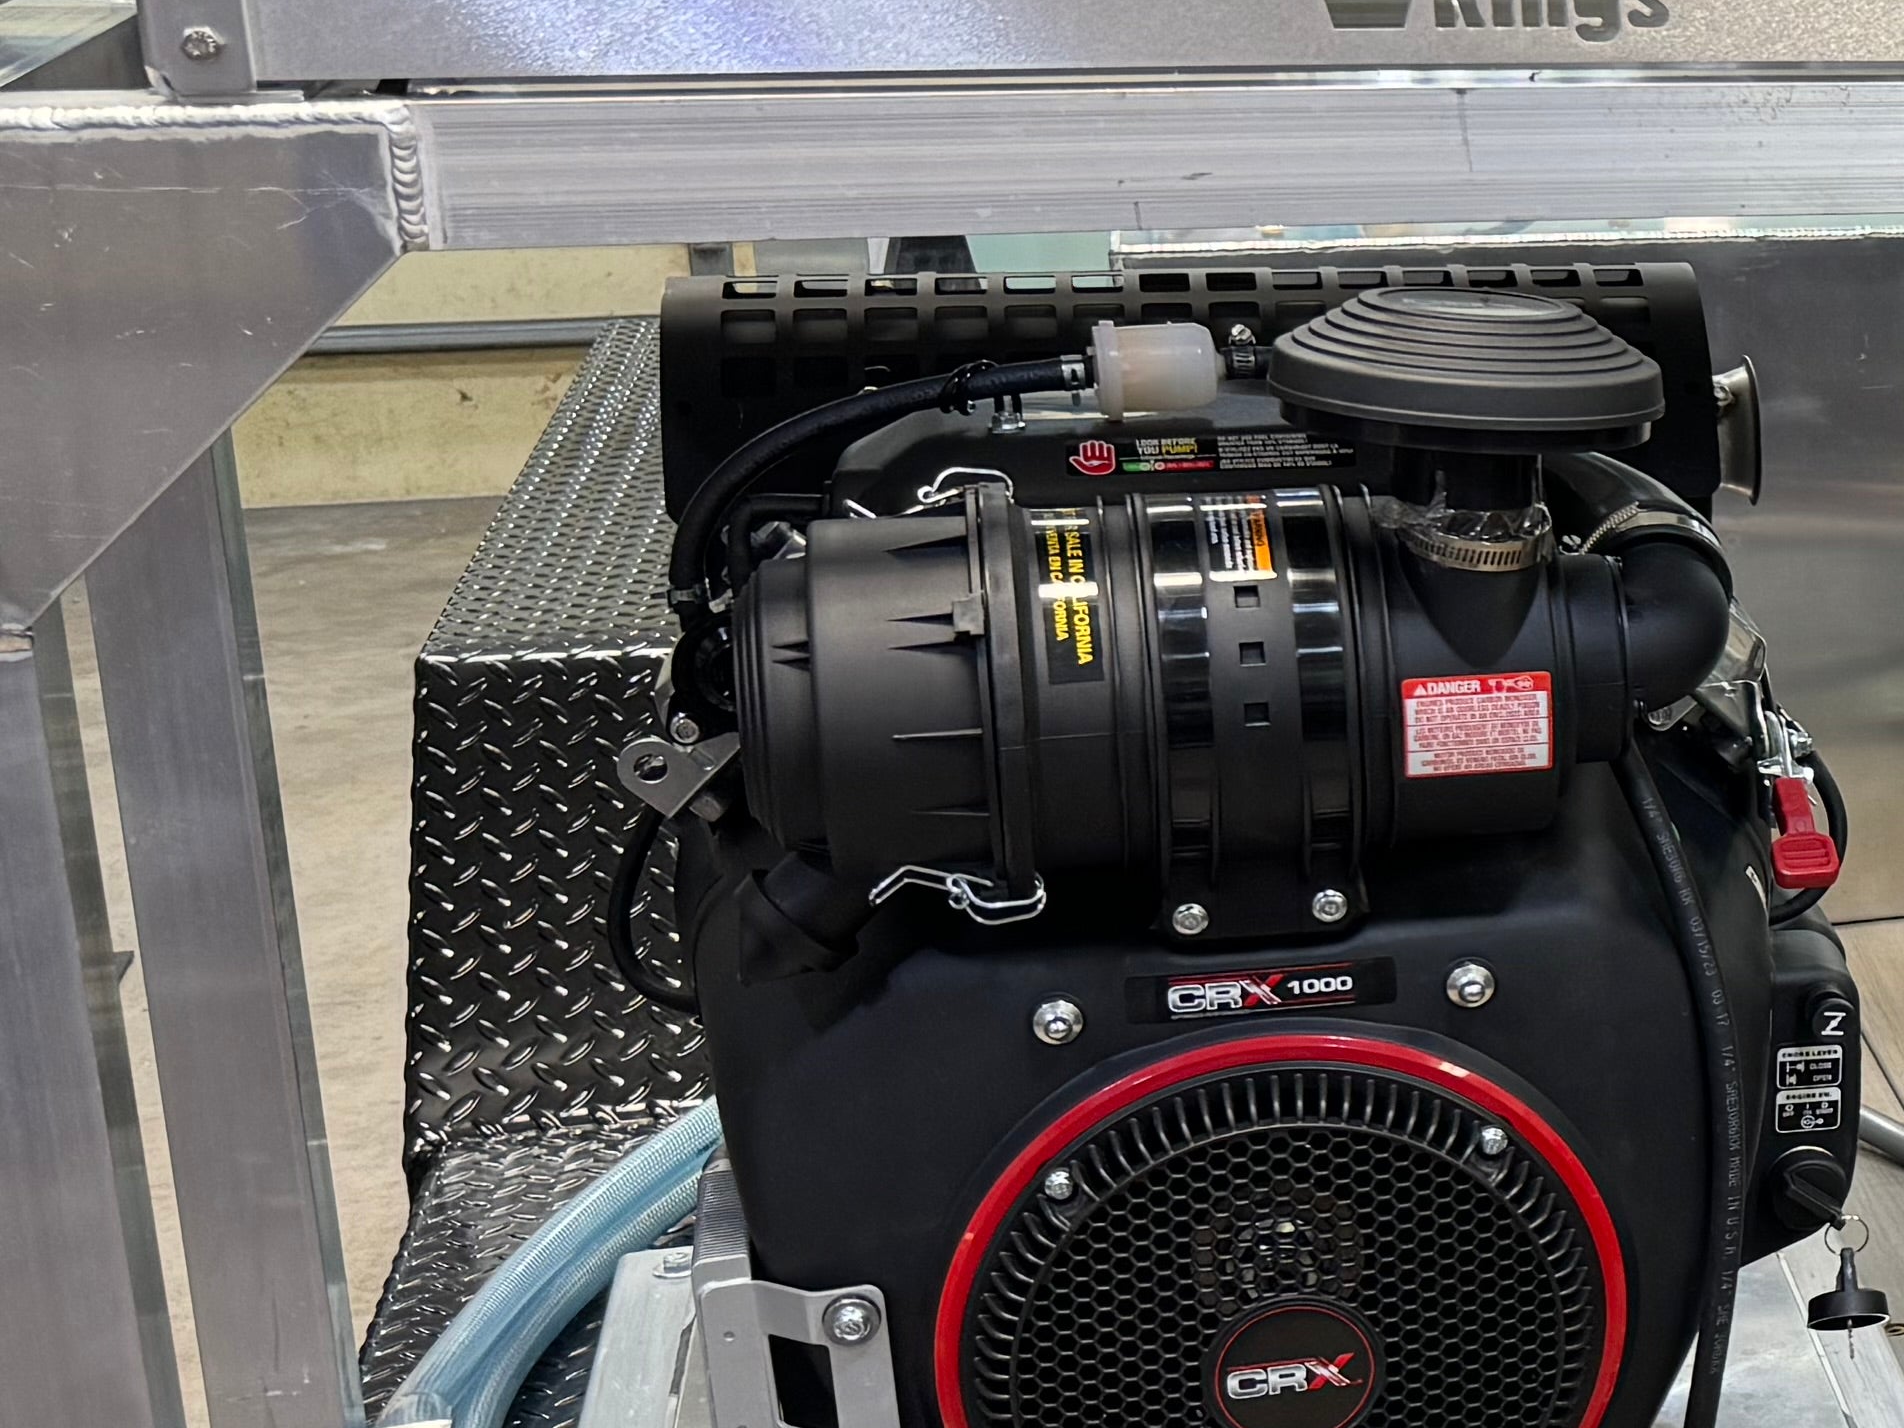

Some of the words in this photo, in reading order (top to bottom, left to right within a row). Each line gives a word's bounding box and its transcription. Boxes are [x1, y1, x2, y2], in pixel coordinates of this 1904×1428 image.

[1064, 532, 1083, 557] SALE
[1067, 559, 1085, 573] IN
[1427, 681, 1482, 695] DANGER
[1167, 973, 1284, 1013] CRX
[1287, 975, 1353, 995] 1000
[1226, 1352, 1355, 1399] CRX
